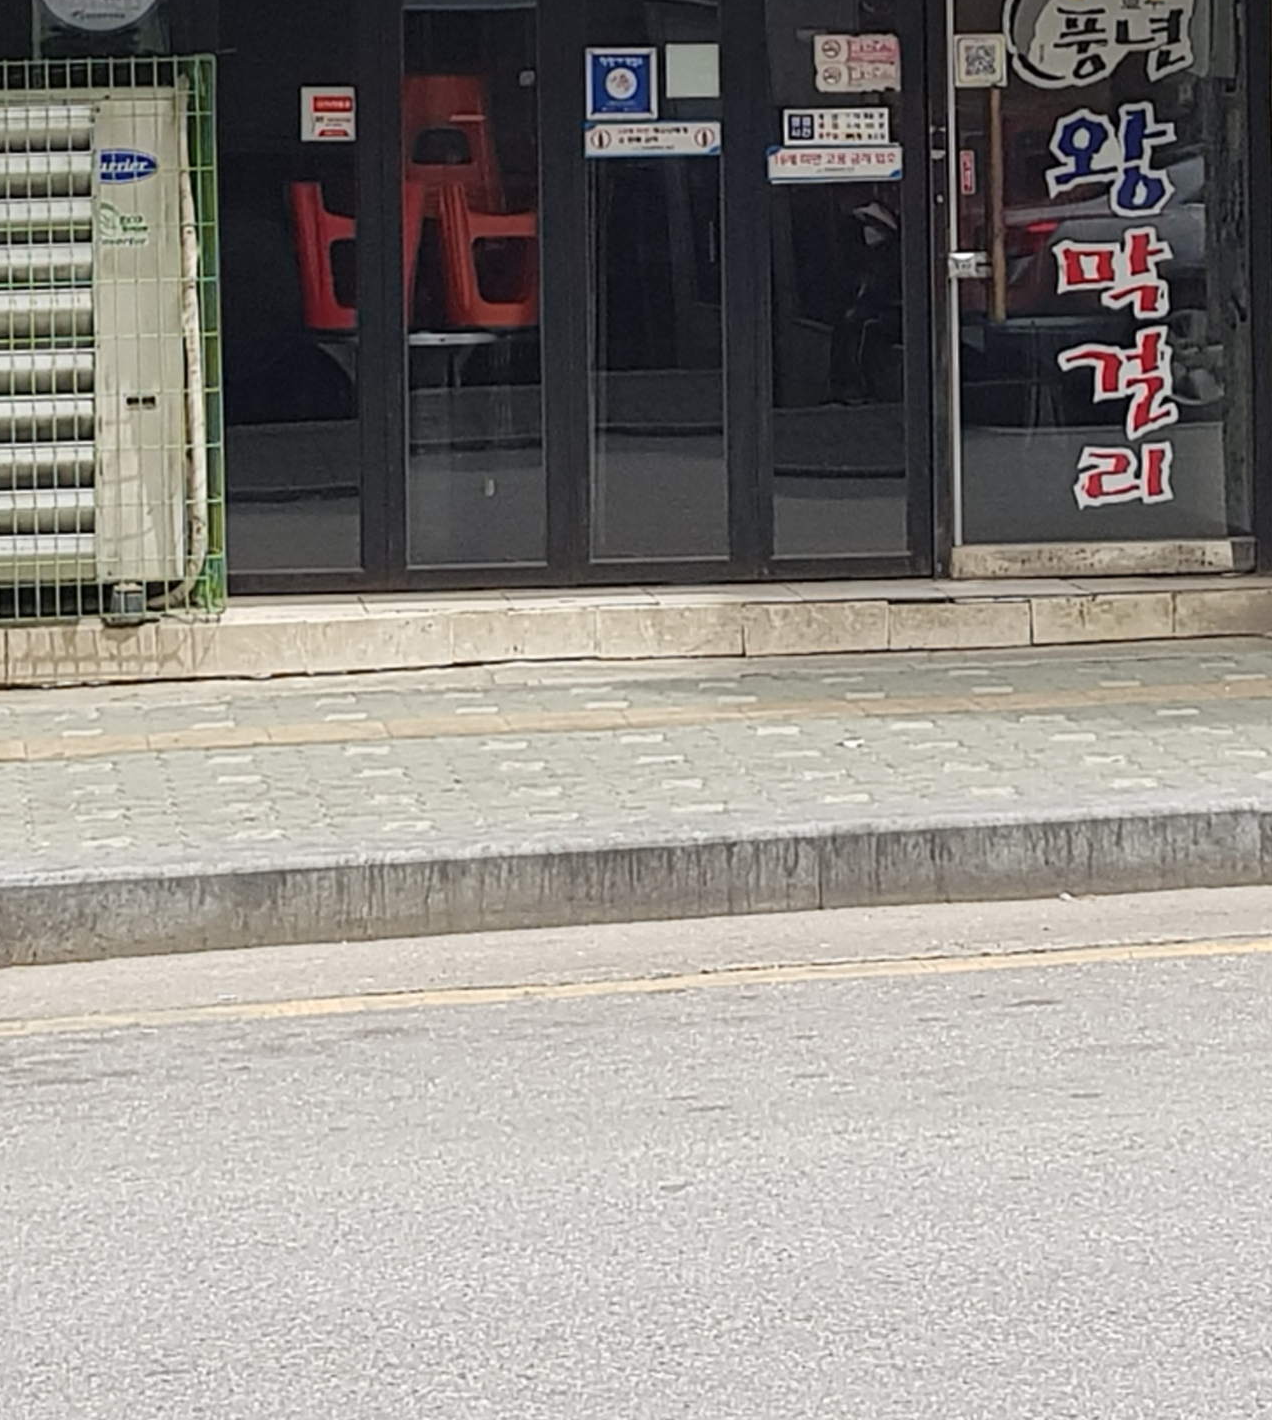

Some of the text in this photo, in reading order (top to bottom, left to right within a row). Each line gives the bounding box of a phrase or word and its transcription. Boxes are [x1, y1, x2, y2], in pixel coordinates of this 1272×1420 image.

[1051, 7, 1186, 499] 풍년 왕 막걸리
